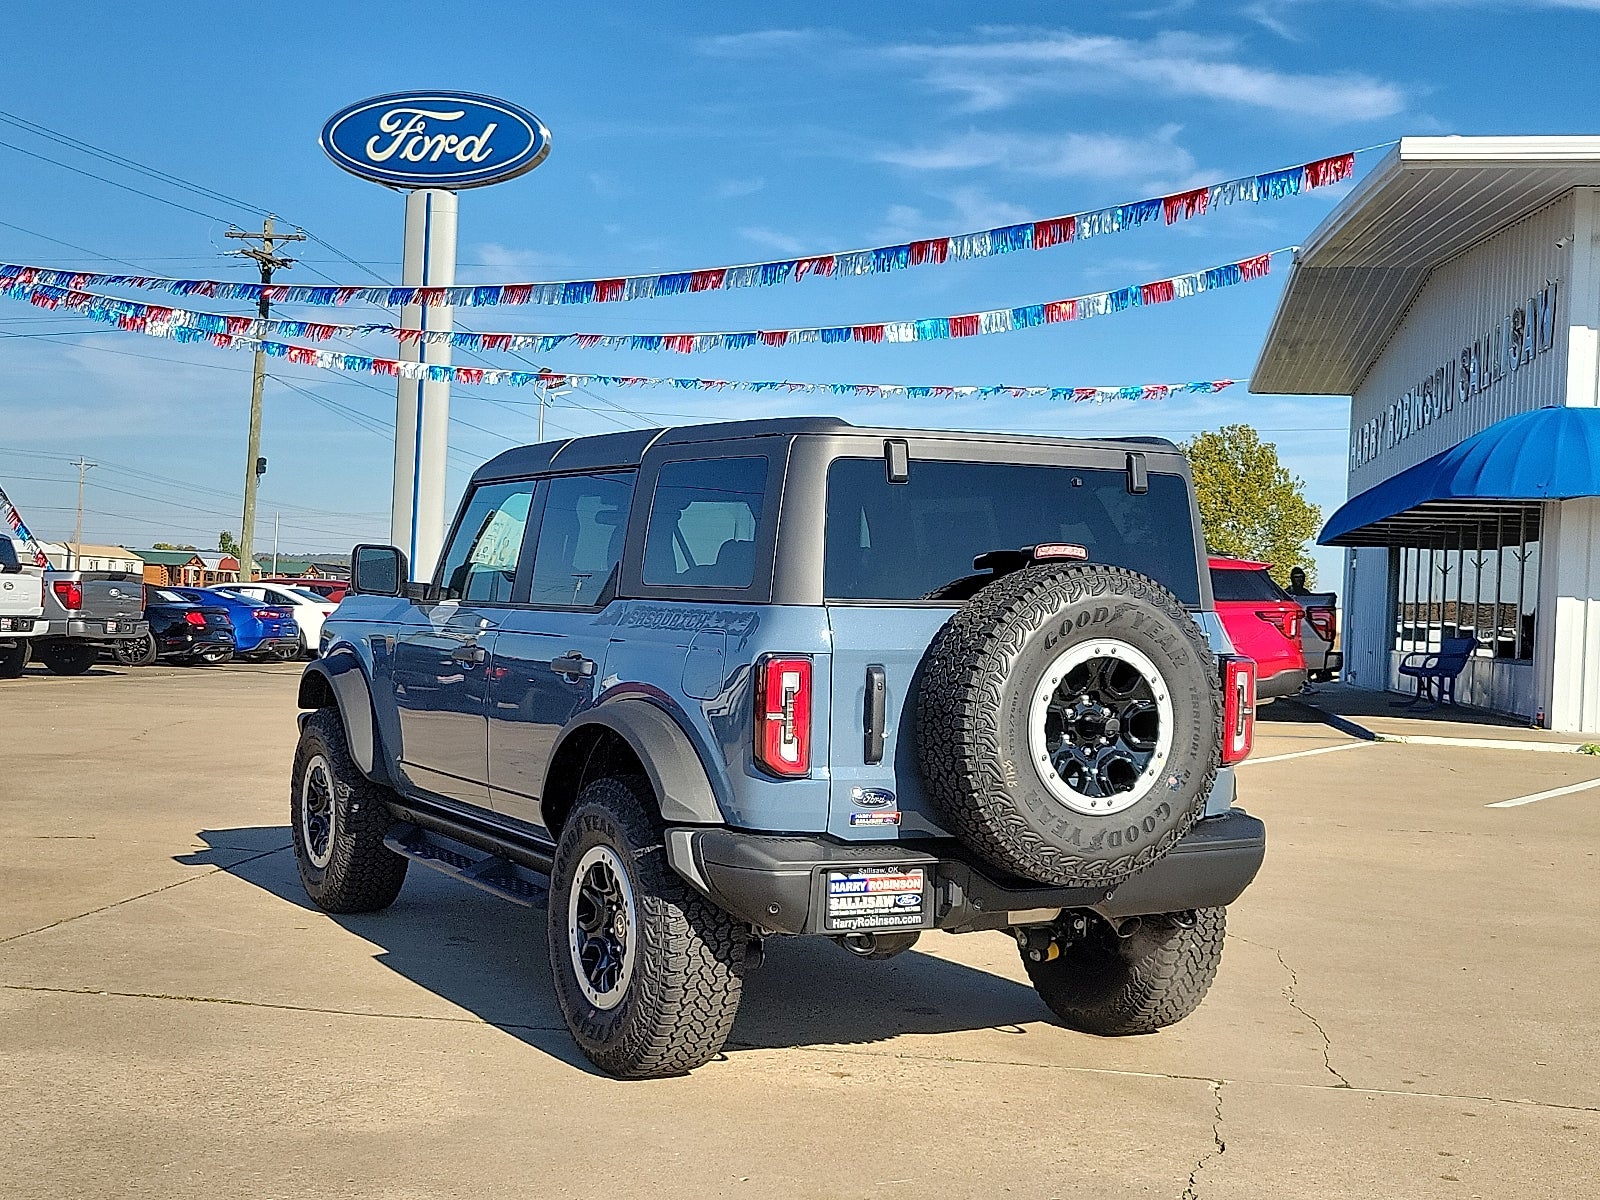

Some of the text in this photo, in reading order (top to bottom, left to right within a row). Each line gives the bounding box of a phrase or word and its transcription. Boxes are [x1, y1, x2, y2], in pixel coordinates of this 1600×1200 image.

[366, 108, 498, 162] Ford
[1349, 281, 1558, 472] HARRY ROBINSON SALLISAW
[628, 608, 710, 629] SASQUATCH
[862, 792, 887, 804] Ford
[831, 879, 921, 893] HARRY ROBINSON
[829, 895, 896, 910] SALLISAW
[832, 915, 922, 930] HarryRobinson.com
